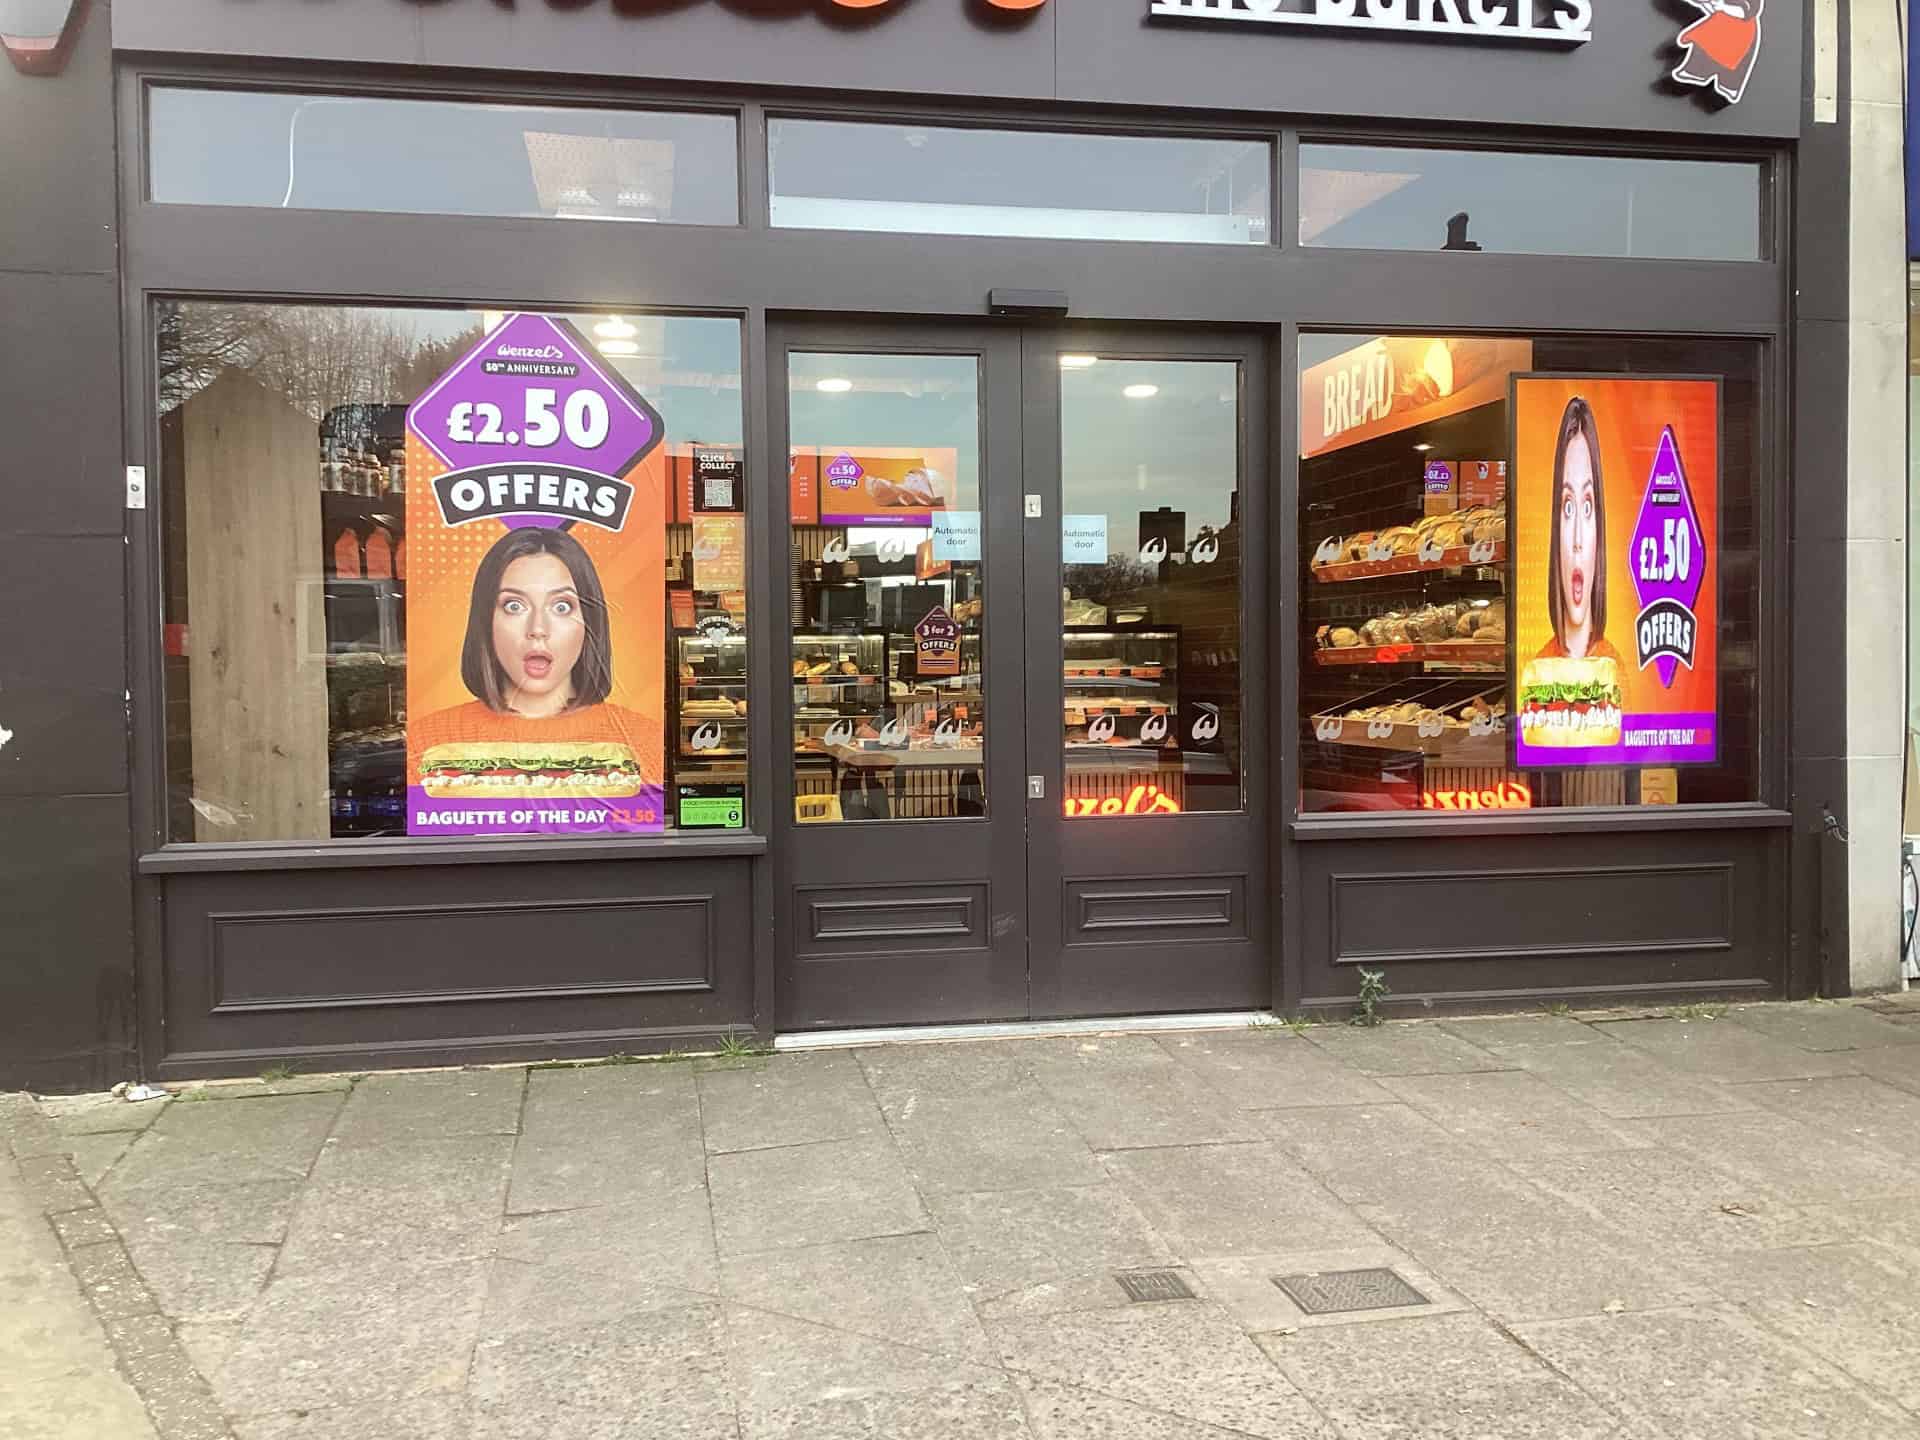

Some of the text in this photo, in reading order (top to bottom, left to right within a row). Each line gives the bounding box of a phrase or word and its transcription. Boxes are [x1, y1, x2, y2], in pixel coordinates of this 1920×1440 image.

[497, 343, 564, 359] Wenzel's
[506, 363, 576, 376] ANNIVERSARY
[1324, 353, 1394, 437] BREAD
[446, 388, 610, 449] £2.50
[700, 454, 724, 463] CLICK
[700, 462, 736, 471] COLLECT
[450, 474, 618, 517] OFFERS
[934, 527, 978, 535] Automatic
[1063, 529, 1105, 537] Automatic
[946, 537, 967, 545] door
[1074, 541, 1094, 549] door
[1639, 517, 1690, 581] £2.50
[923, 625, 955, 636] 3 for 2
[1640, 612, 1691, 655] OFFERS
[921, 641, 955, 650] OFFERS
[1681, 729, 1695, 745] DAY
[416, 811, 506, 826] BAGUETTE
[511, 811, 534, 825] OF
[537, 811, 570, 825] THE
[574, 810, 608, 824] DAY
